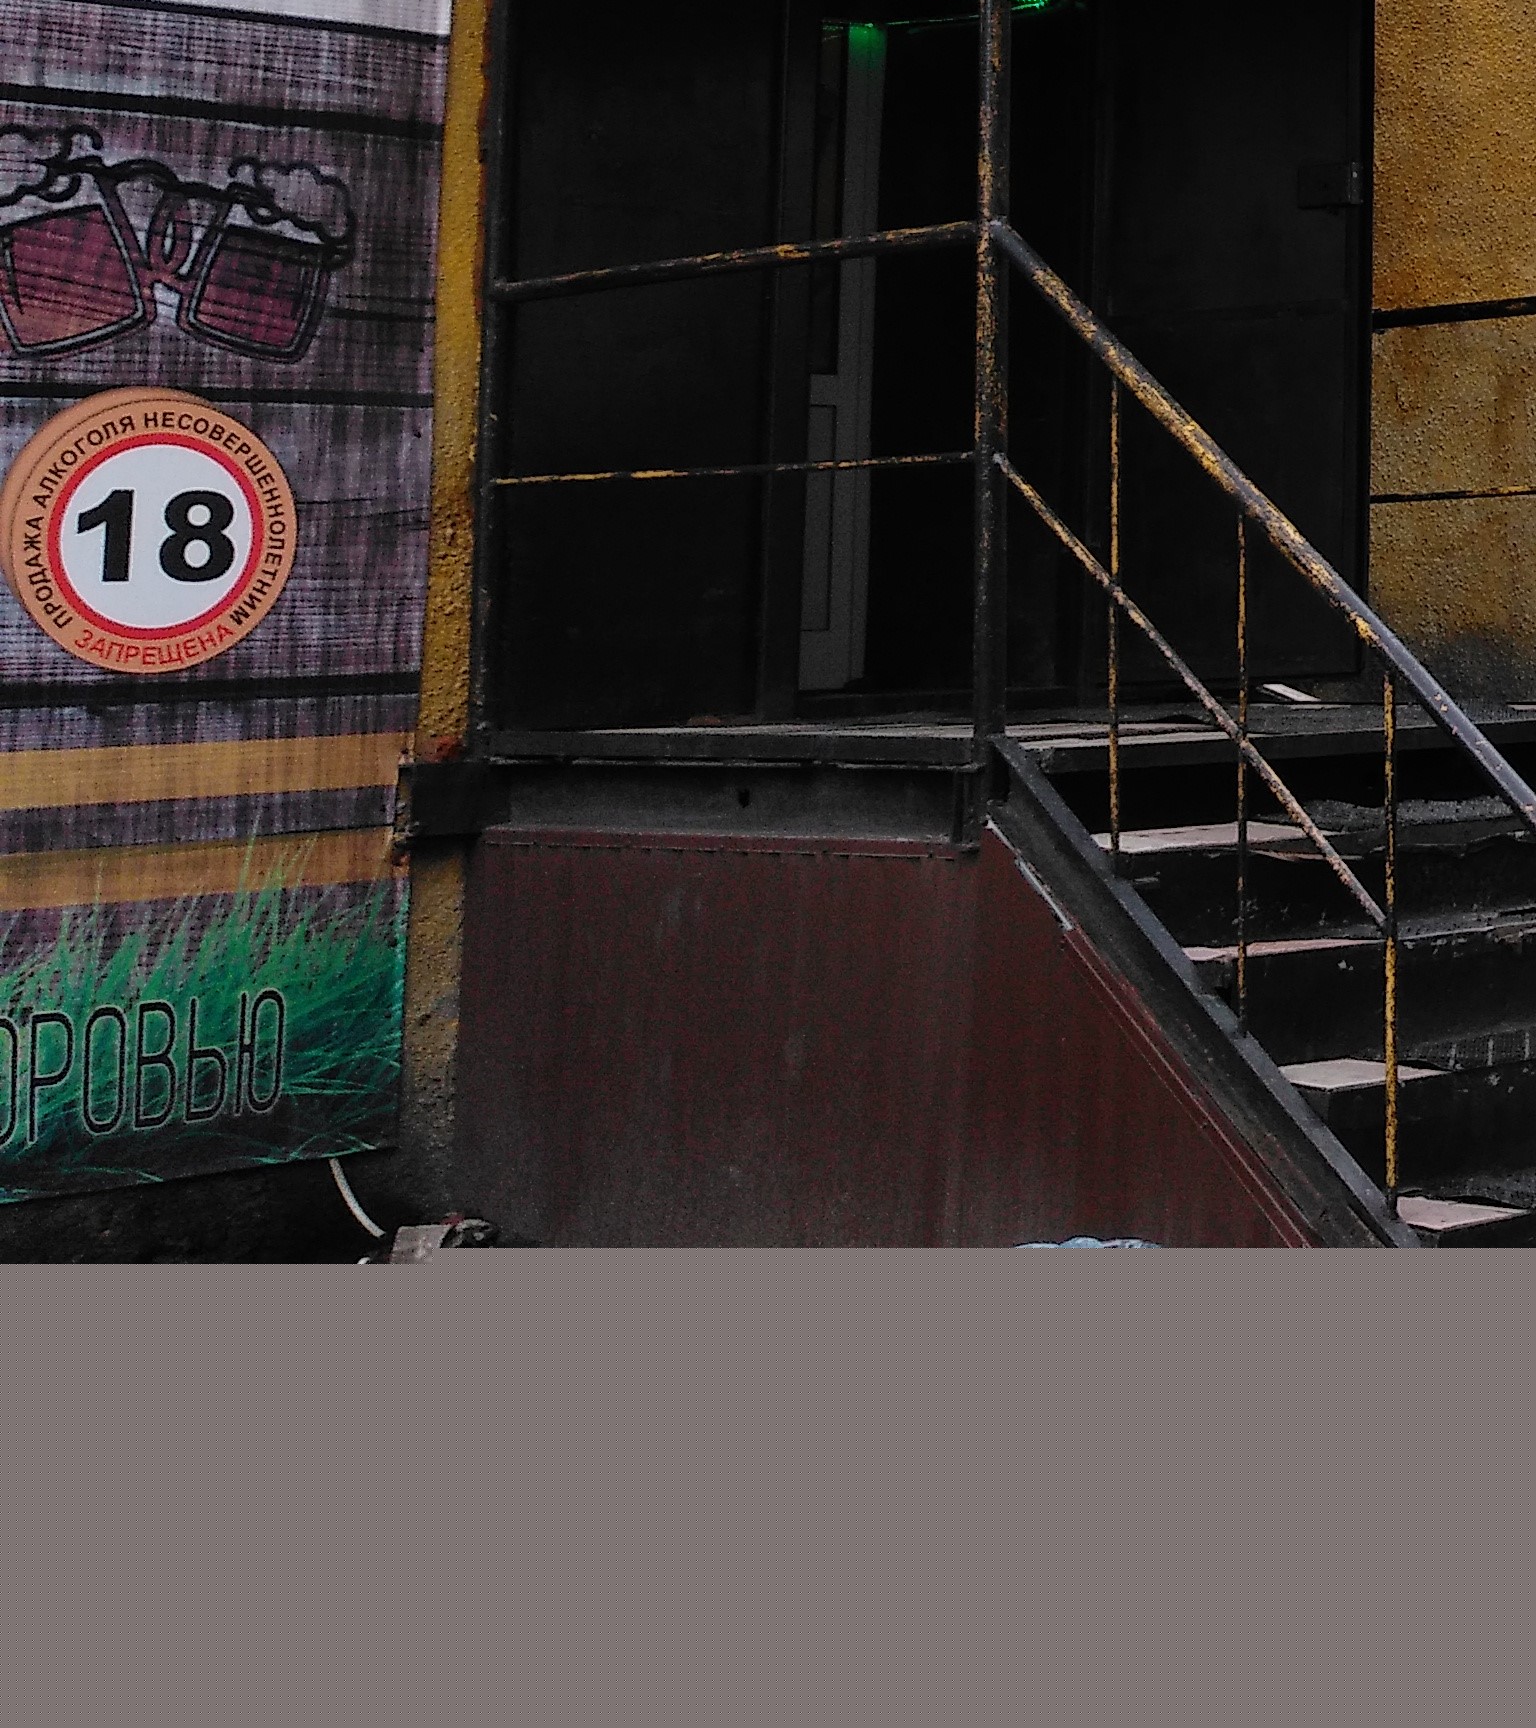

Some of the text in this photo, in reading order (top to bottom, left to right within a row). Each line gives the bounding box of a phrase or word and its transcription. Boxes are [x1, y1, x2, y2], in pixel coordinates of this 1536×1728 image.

[24, 411, 286, 628] ПРОДАЖА АЛКОГОЛЯ НЕСОВЕРШЕННОЛЕТНИМ
[76, 489, 235, 582] 18
[75, 624, 234, 664] ЗАПРЕЩЕНА
